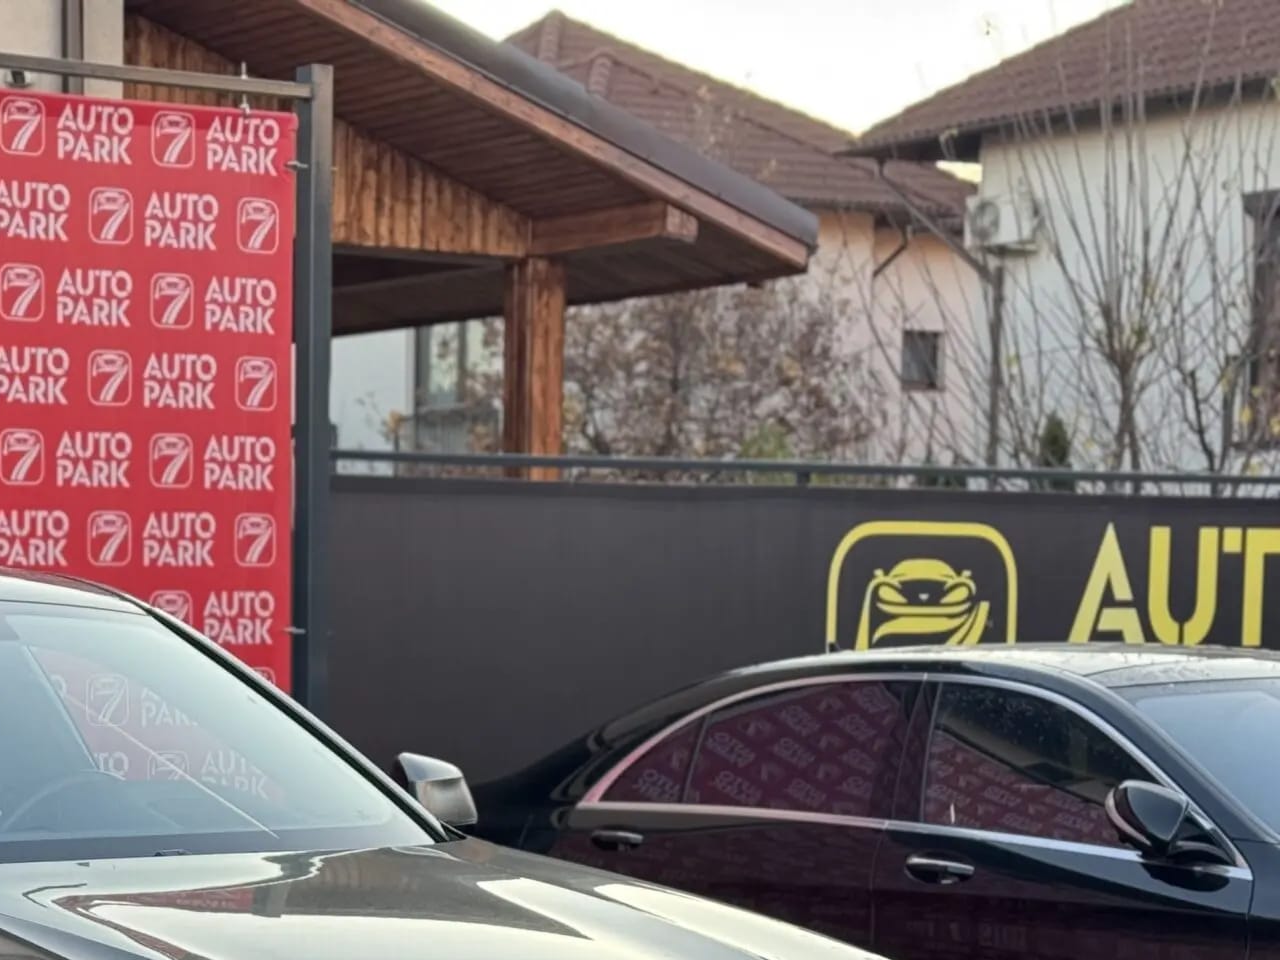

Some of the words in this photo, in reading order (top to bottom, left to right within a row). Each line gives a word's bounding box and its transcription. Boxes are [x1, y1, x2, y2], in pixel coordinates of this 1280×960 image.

[57, 105, 133, 135] AUTO
[206, 112, 279, 146] AUTO
[58, 131, 131, 164] PARK
[207, 142, 276, 176] PARK
[145, 193, 218, 221] AUTO
[145, 219, 215, 250] PARK
[57, 269, 132, 298] AUTO
[205, 277, 276, 306] AUTO
[57, 296, 129, 326] PARK
[206, 304, 274, 334] PARK
[144, 353, 217, 381] AUTO
[144, 380, 214, 409] PARK
[57, 432, 132, 459] AUTO
[204, 436, 275, 463] AUTO
[57, 459, 129, 487] PARK
[205, 462, 272, 490] PARK
[143, 512, 216, 540] AUTO
[144, 540, 213, 566] PARK
[204, 591, 274, 617] AUTO
